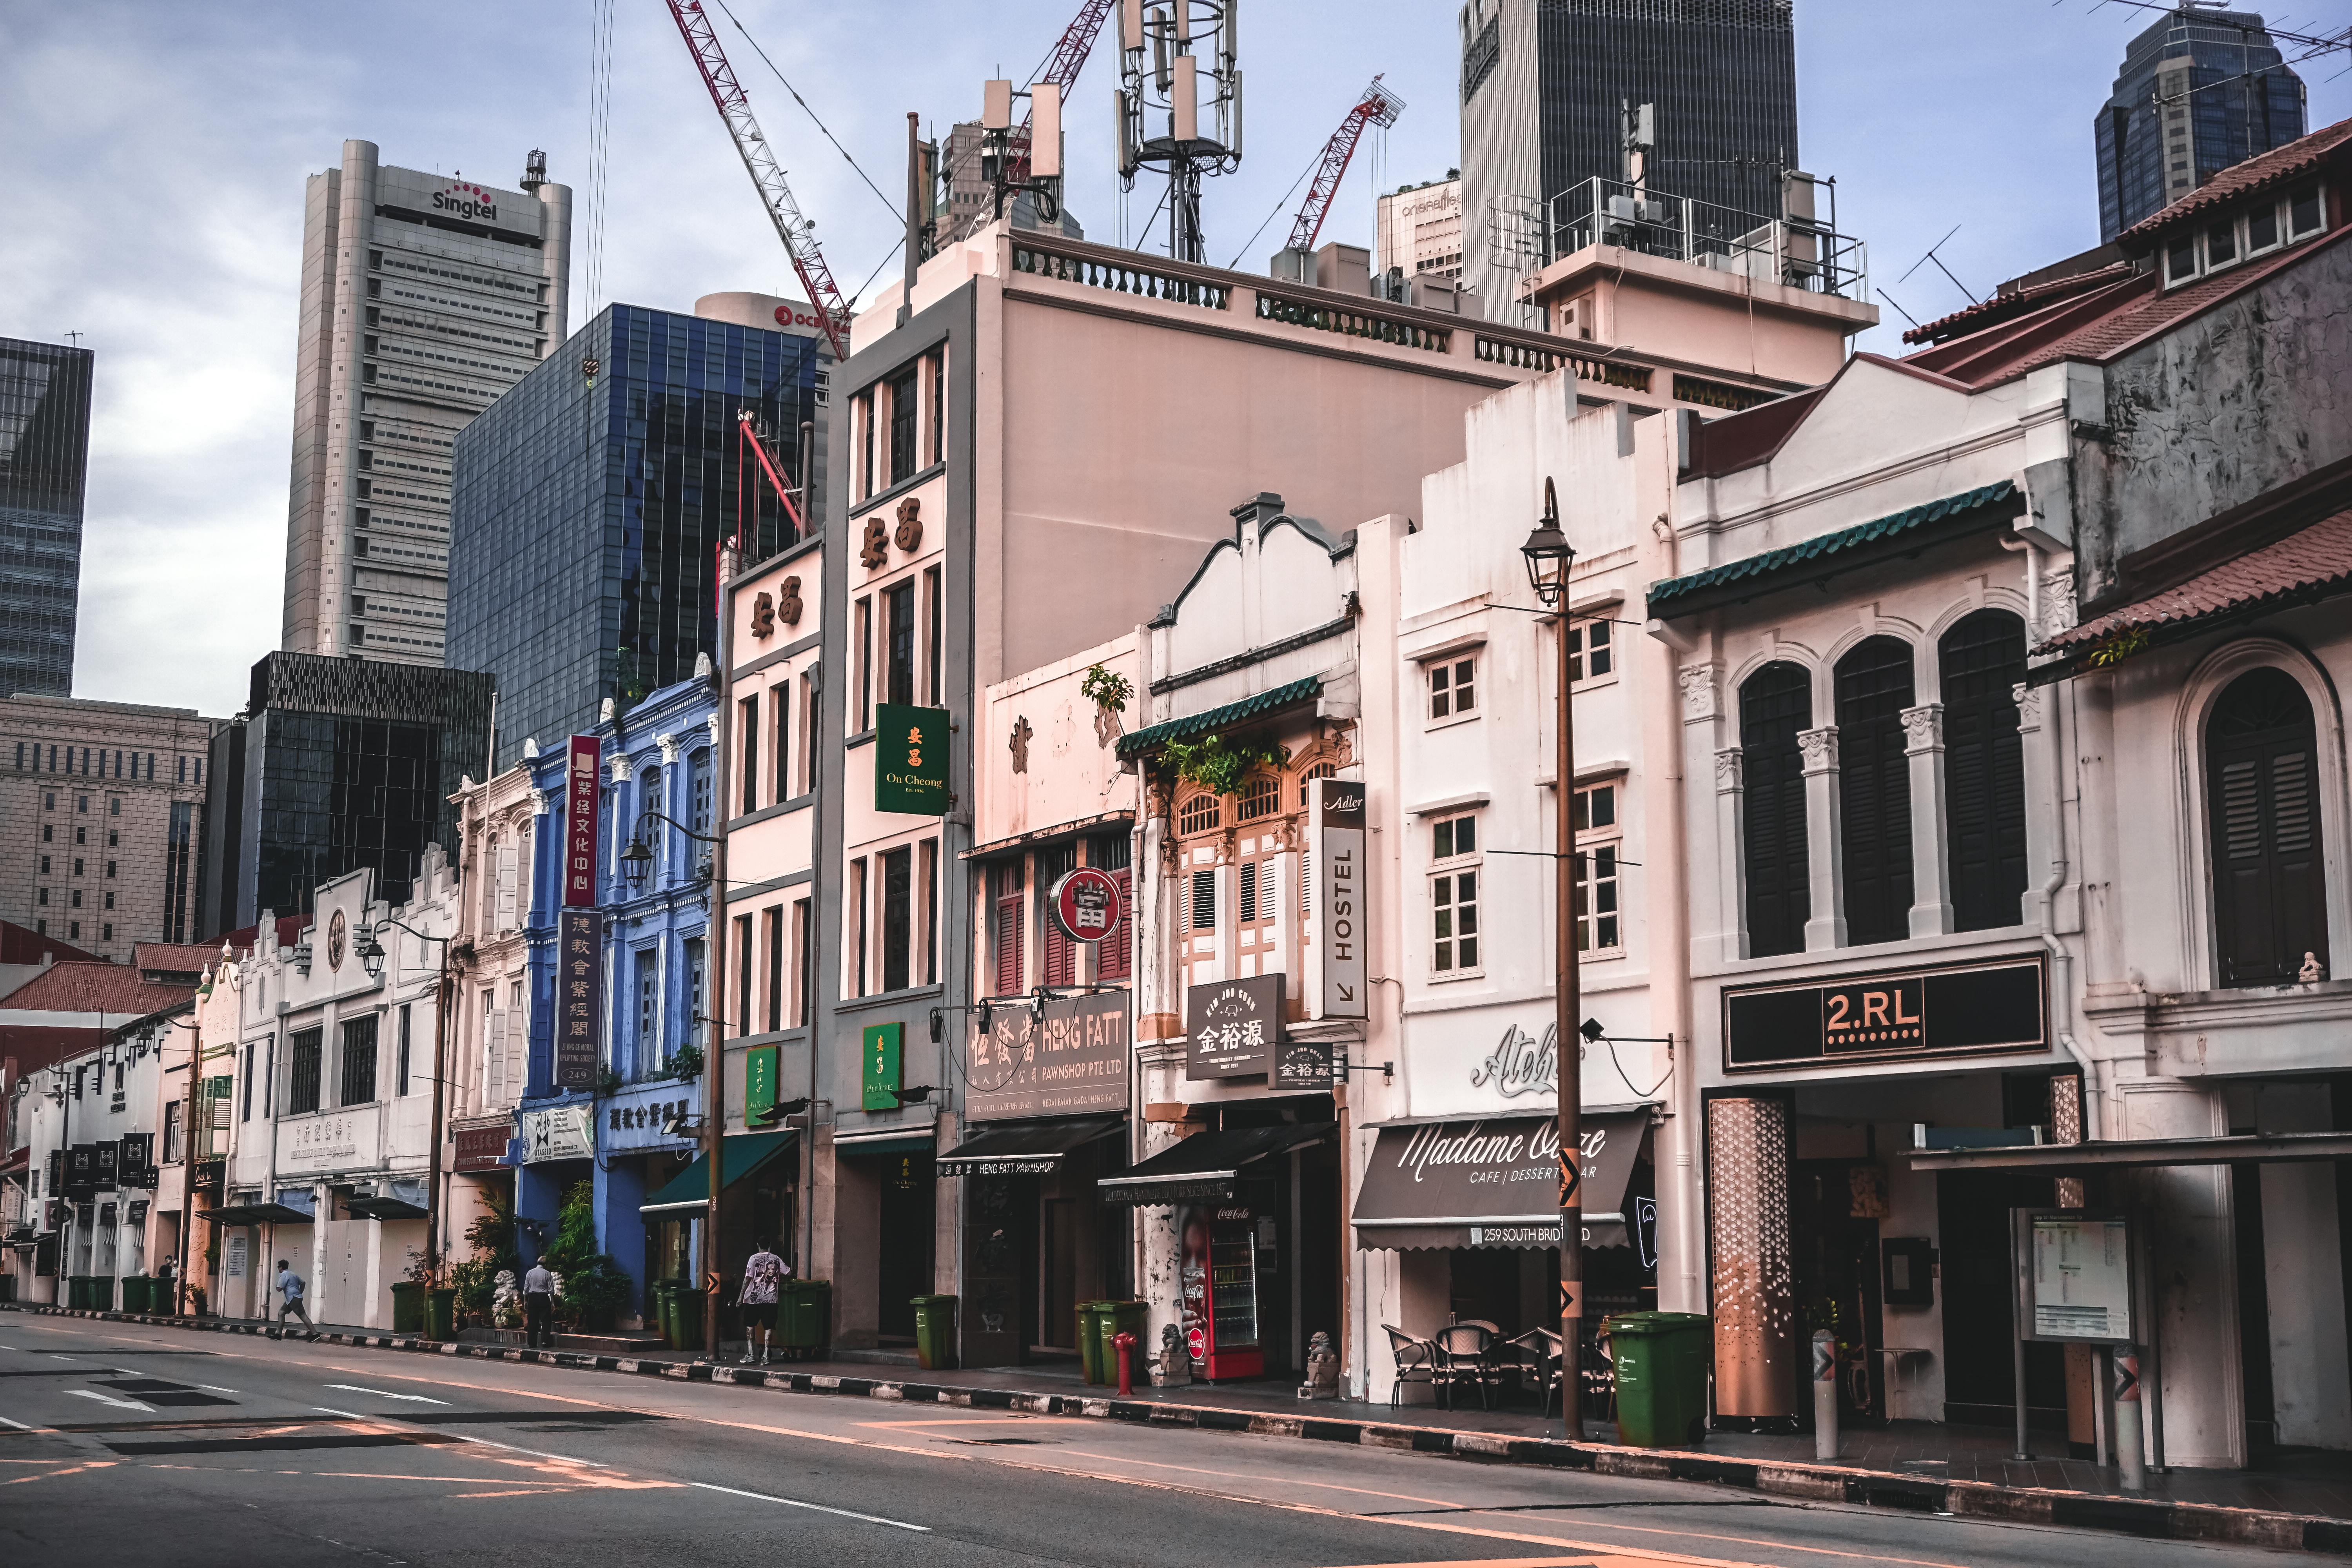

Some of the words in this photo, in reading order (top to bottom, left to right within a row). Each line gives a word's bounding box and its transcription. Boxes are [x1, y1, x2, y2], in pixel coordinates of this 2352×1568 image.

[432, 188, 497, 220] Singtel
[795, 314, 823, 328] OCB
[907, 726, 922, 766] 安昌
[886, 773, 902, 783] On
[905, 775, 942, 789] Cheong
[1324, 795, 1363, 813] Adler
[574, 781, 592, 889] 紫经文化中心
[1072, 878, 1109, 931] 當
[1335, 849, 1352, 961] HOSTEL
[570, 917, 591, 1037] 德教會紫經閣
[1206, 998, 1219, 1018] KIM
[1222, 988, 1235, 1000] JOO
[1238, 989, 1256, 1012] GUAN
[1828, 989, 1919, 1031] 2.RL
[1042, 1016, 1080, 1052] HENG
[1087, 1011, 1122, 1047] FATT
[1197, 1020, 1265, 1054] 金裕源
[1285, 1050, 1295, 1060] KIM
[1310, 1049, 1323, 1060] GUAN
[1042, 1063, 1085, 1081] PAWNSHOP
[1089, 1061, 1103, 1076] PTE
[1107, 1059, 1122, 1075] LTD
[1279, 1063, 1331, 1076] 金裕源
[1043, 1098, 1056, 1107] KEDAI
[1058, 1097, 1072, 1106] PAJAK
[1074, 1096, 1089, 1105] GADAI
[1091, 1094, 1104, 1103] HENG
[1106, 1093, 1118, 1102] FATT
[535, 1148, 551, 1157] ATASBID
[1397, 1120, 1524, 1182] Madame
[980, 1163, 997, 1174] HENG
[999, 1162, 1014, 1174] FATT
[1016, 1161, 1054, 1173] PAWNSHOP
[1470, 1172, 1501, 1183] CAFE
[1581, 1167, 1597, 1178] AR
[1187, 1184, 1200, 1197] SLICE
[1201, 1183, 1215, 1196] SINCE
[712, 1196, 716, 1211] 33
[1484, 1229, 1501, 1241] 259
[1503, 1228, 1536, 1241] SOUTH
[1538, 1228, 1561, 1241] BRID
